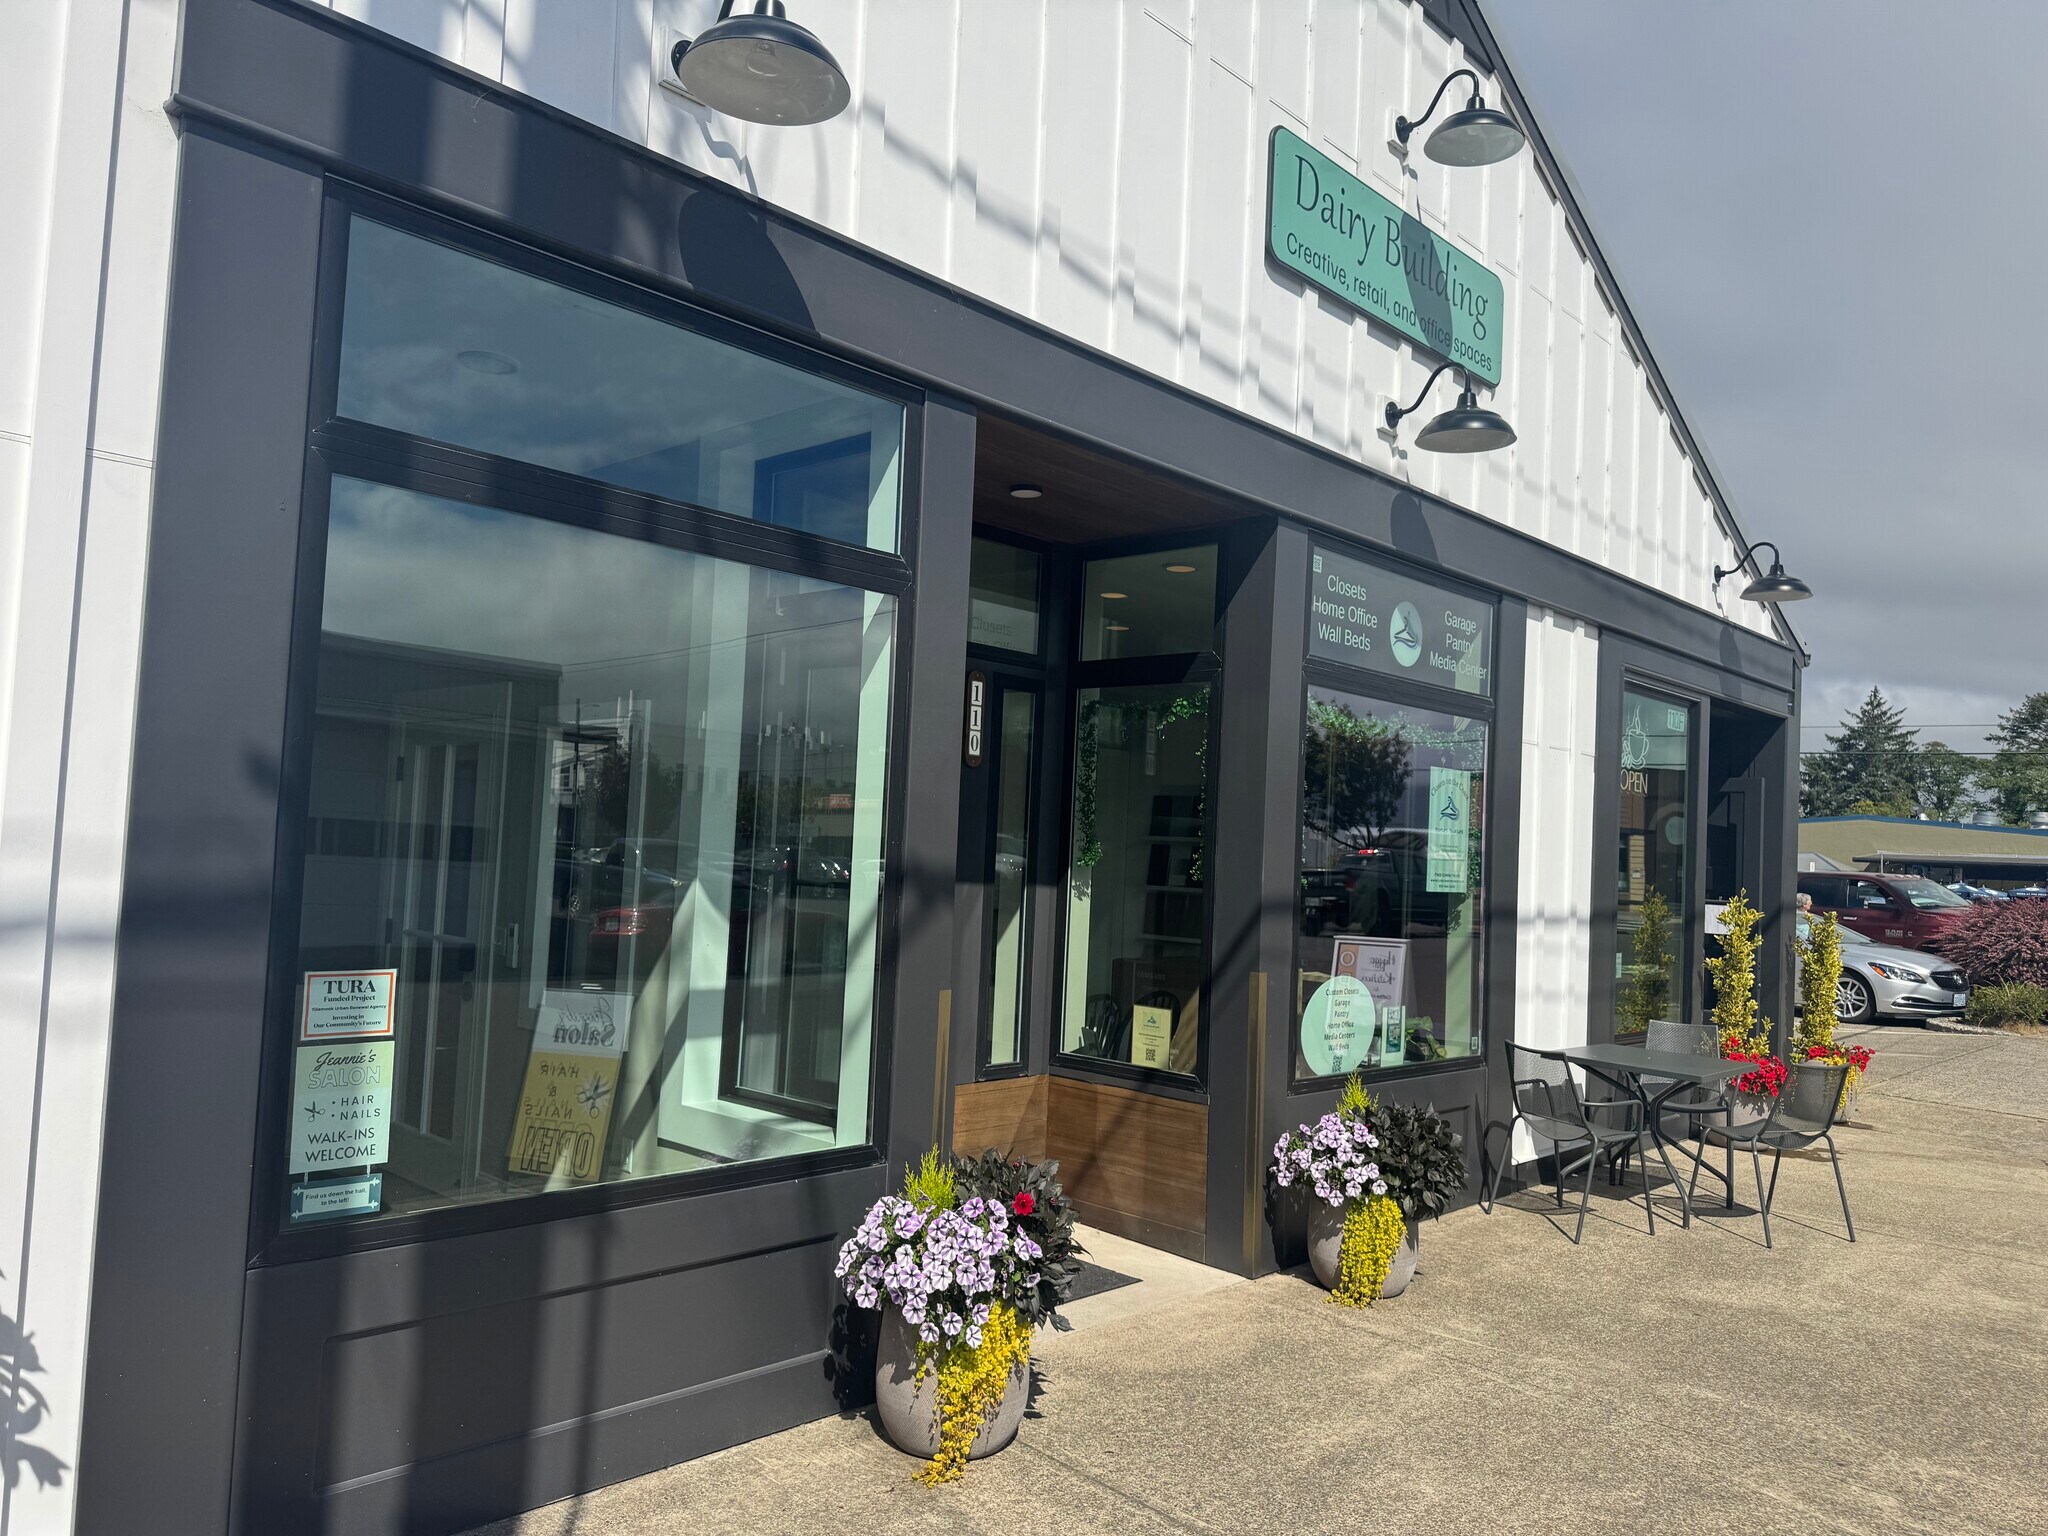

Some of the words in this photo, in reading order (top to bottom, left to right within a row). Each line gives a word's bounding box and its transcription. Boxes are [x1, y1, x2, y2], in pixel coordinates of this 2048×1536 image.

[1295, 154, 1376, 266] Dairy
[1384, 215, 1489, 340] Building
[1286, 232, 1350, 291] Creative,
[1353, 277, 1390, 315] retail,
[1393, 299, 1417, 327] and
[1420, 315, 1451, 347] office
[1454, 337, 1492, 372] spaces
[1327, 575, 1367, 601] Closets
[1312, 595, 1345, 619] Home
[1348, 606, 1378, 629] Office
[1444, 610, 1477, 636] Garage
[1318, 622, 1342, 643] Wall
[1344, 629, 1371, 651] Beds
[1446, 633, 1475, 658] Pantry
[1429, 651, 1457, 672] Media
[1458, 659, 1487, 680] Center
[969, 684, 982, 753] 110
[1620, 768, 1648, 794] OPEN
[323, 979, 376, 994] TURA
[323, 995, 350, 1003] Funded
[351, 994, 376, 1002] Project
[1335, 1000, 1350, 1008] Garage
[315, 1049, 376, 1072] Jeannie's
[308, 1065, 381, 1090] SALON
[341, 1095, 374, 1106] HAIR
[340, 1108, 381, 1120] NAILS
[307, 1127, 375, 1144] WALK-INS
[305, 1144, 376, 1162] WELCOME
